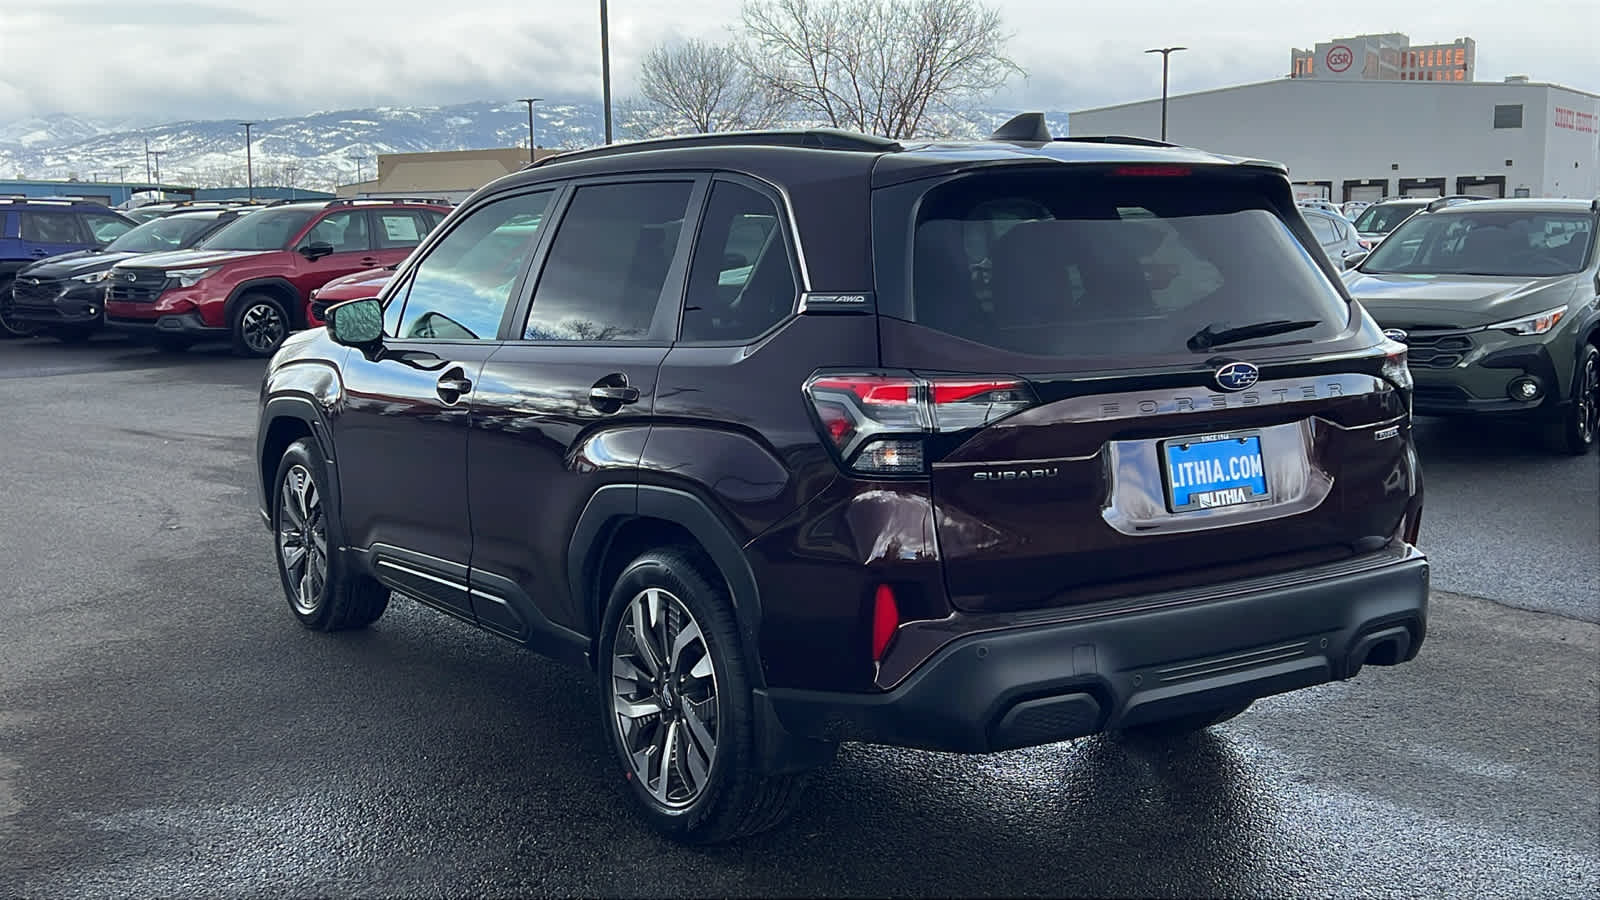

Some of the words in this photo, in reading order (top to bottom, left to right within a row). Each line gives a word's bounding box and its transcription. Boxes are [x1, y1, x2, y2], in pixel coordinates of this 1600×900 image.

[1330, 53, 1349, 65] GSR
[835, 295, 865, 303] AWD
[1102, 382, 1344, 415] FORESTER
[973, 467, 1058, 481] SUBARU
[1169, 453, 1263, 489] LITHIA.COM
[1209, 487, 1246, 507] LITHIA
